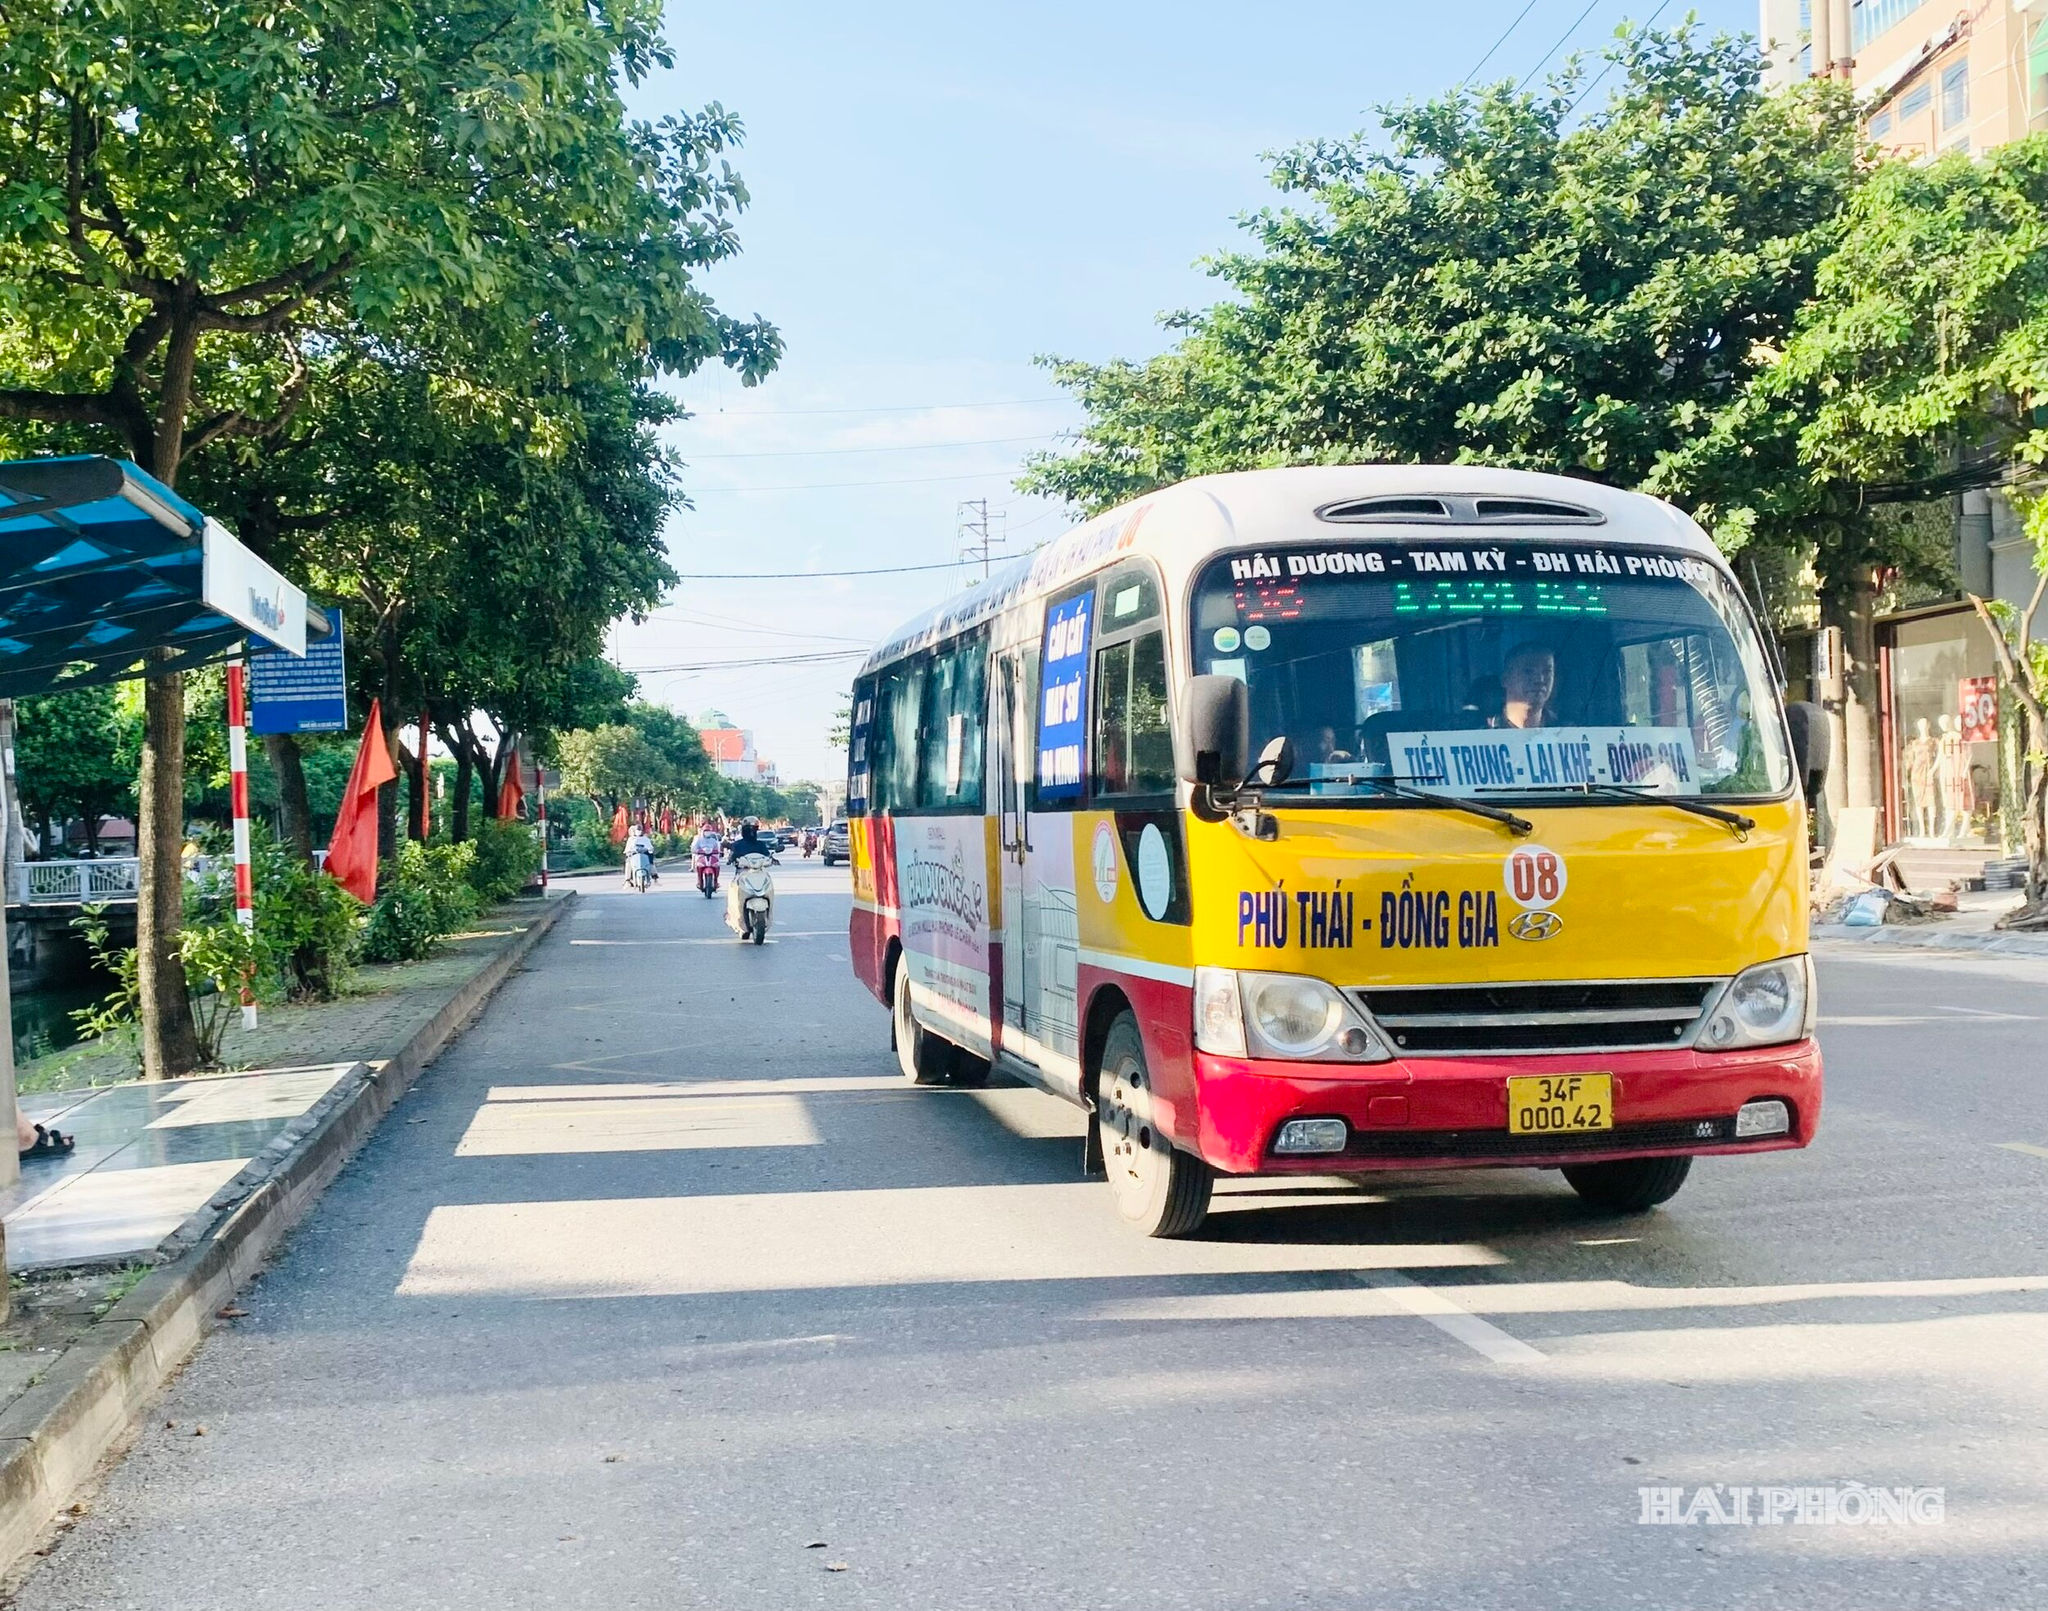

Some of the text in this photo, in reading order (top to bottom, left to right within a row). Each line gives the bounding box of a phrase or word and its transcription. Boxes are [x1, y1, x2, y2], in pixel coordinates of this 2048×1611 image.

[1231, 552, 1281, 580] HẢI
[1287, 551, 1385, 575] DƯƠNG
[1408, 552, 1468, 571] TAM
[1472, 548, 1506, 571] KỲ
[1532, 552, 1571, 572] ĐH
[1574, 550, 1621, 574] HẢI
[1624, 554, 1709, 581] PHÒNG
[1404, 734, 1450, 787] TIỀN
[1450, 744, 1515, 785] TRUNG
[1525, 743, 1559, 785] LAI
[1560, 734, 1597, 783] KHÊ
[1606, 730, 1655, 783] ĐỒNG
[1512, 852, 1559, 902] 08
[1238, 879, 1288, 948] PHÚ
[1297, 879, 1353, 948] THÁI
[1380, 872, 1449, 948] ĐỒNG
[1458, 890, 1499, 948] GIA
[1539, 1077, 1582, 1102] 34F
[1520, 1104, 1602, 1131] 000.42
